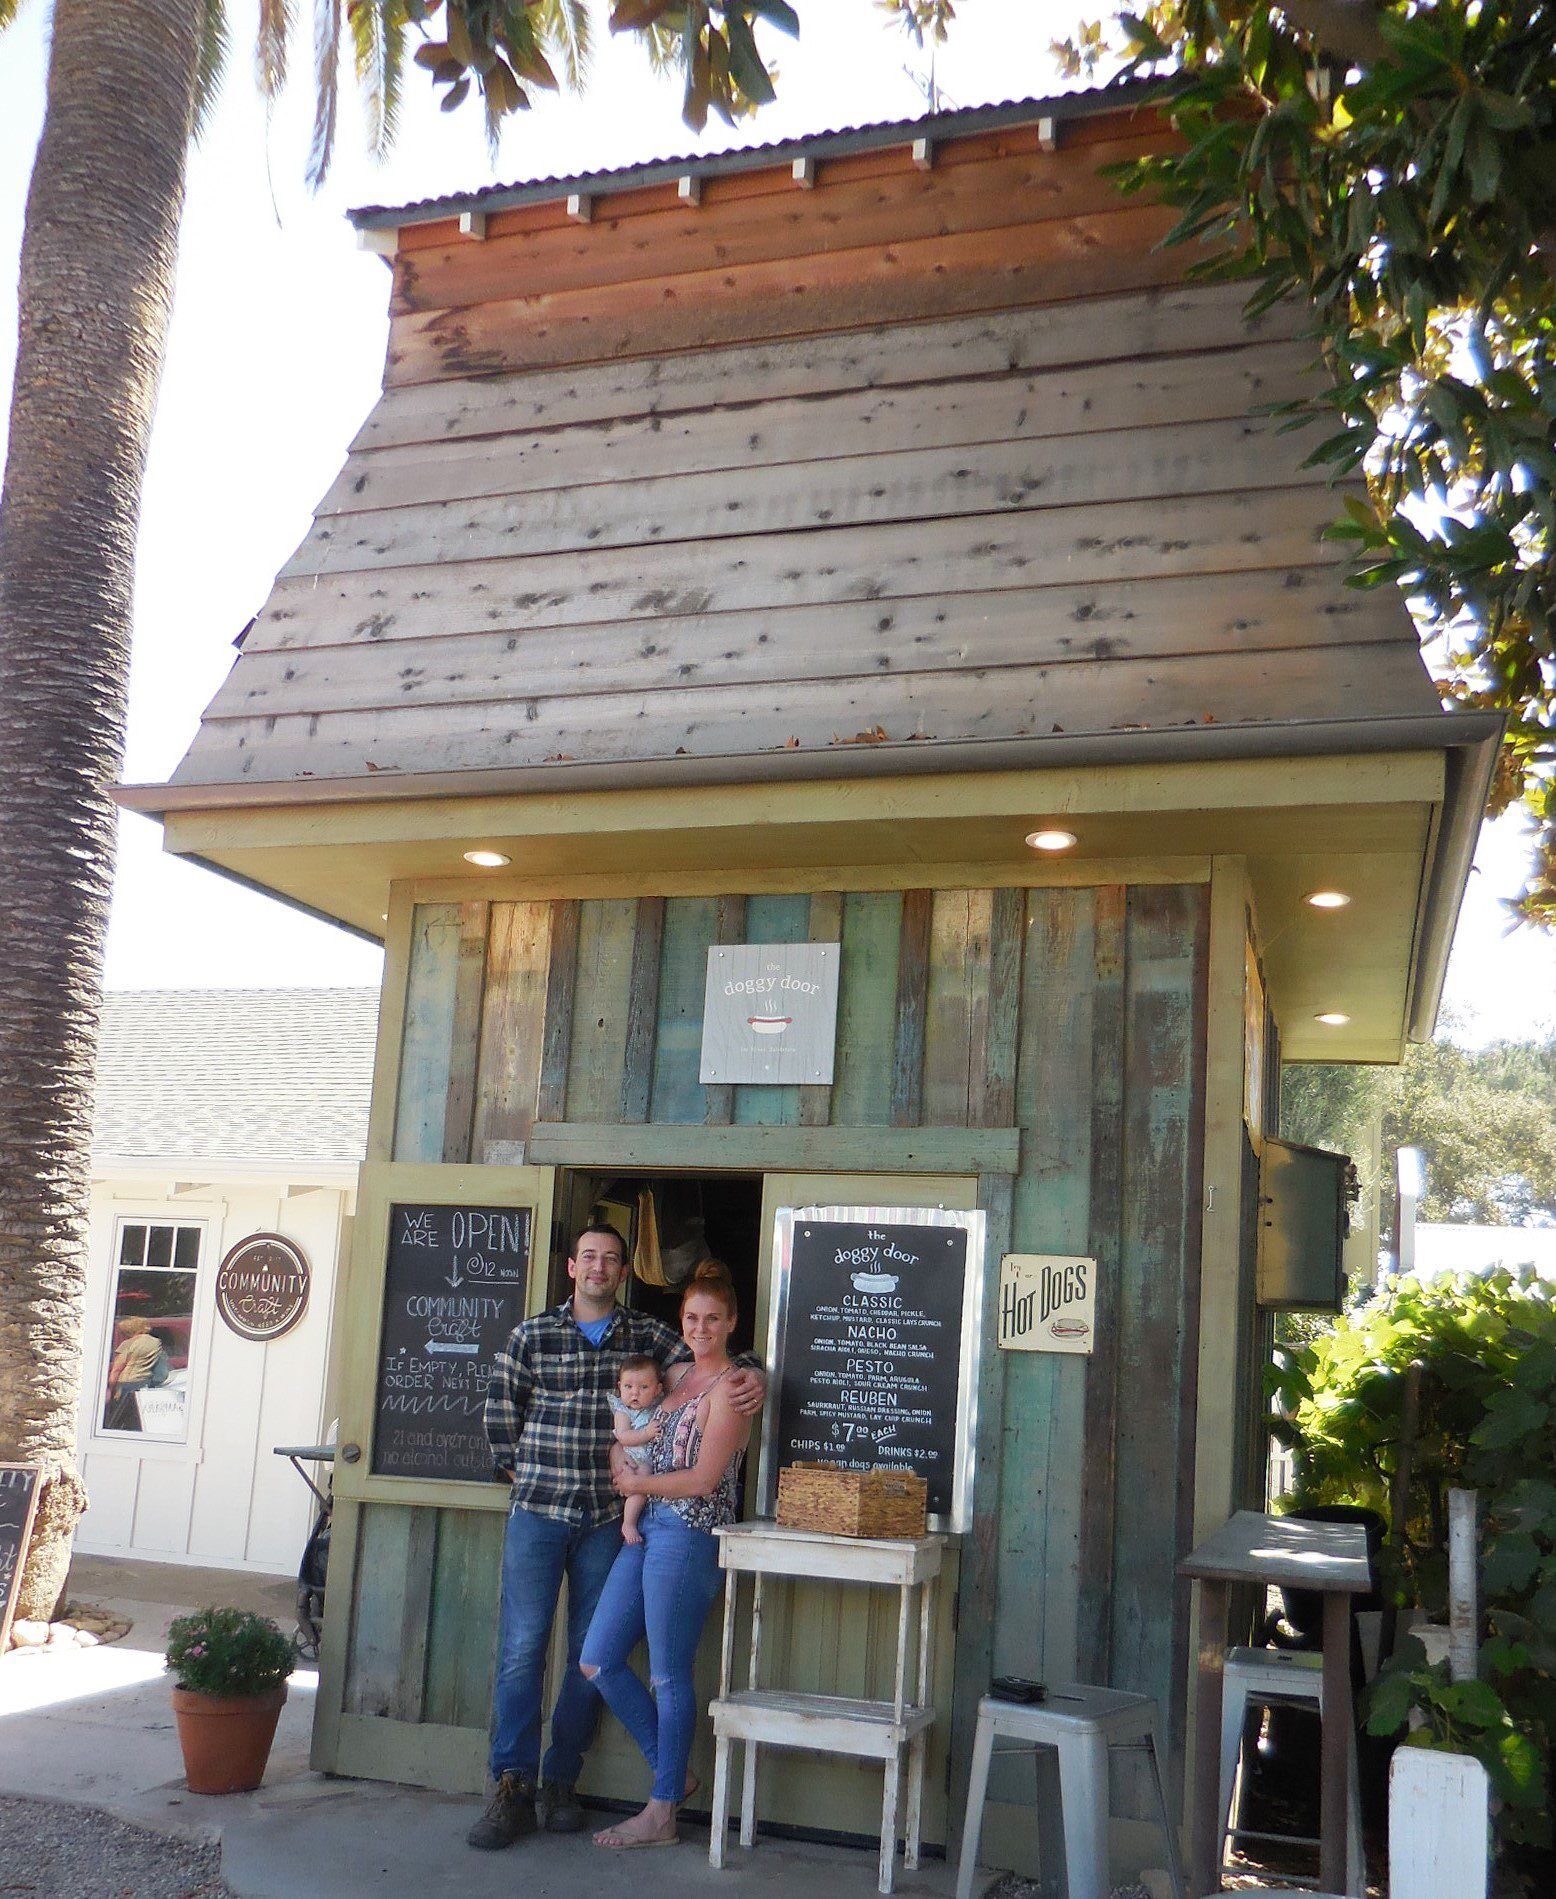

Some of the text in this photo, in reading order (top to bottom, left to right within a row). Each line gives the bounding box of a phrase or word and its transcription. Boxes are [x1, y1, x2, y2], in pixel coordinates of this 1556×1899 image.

[766, 962, 781, 971] the
[724, 974, 821, 996] doggy door
[404, 1211, 435, 1229] WE
[401, 1229, 439, 1248] ARE
[452, 1211, 530, 1256] OPEN!
[868, 1230, 887, 1241] the
[834, 1242, 920, 1265] doggy door
[219, 1271, 308, 1294] COMMUNITY
[842, 1295, 903, 1309] CLASSIC
[1040, 1265, 1087, 1323] DOGS
[238, 1295, 282, 1315] Craft
[406, 1296, 504, 1319] COMMUNITY
[875, 1317, 901, 1325] CLASSIC
[426, 1317, 482, 1342] Craft
[848, 1325, 897, 1341] NACHO
[866, 1341, 888, 1349] BLACK
[889, 1342, 907, 1351] BEAN
[908, 1343, 927, 1351] SALSA
[883, 1349, 906, 1357] NACHO
[846, 1358, 894, 1374] PESTO
[385, 1374, 434, 1390] ORDER
[810, 1376, 831, 1385] PESTO
[872, 1381, 898, 1390] CREAM
[840, 1389, 898, 1406] REUBEN
[847, 1404, 876, 1413] RUSSIAN
[911, 1409, 932, 1417] ONION
[869, 1413, 882, 1421] LAY
[901, 1415, 932, 1425] CRUNCH
[870, 1424, 897, 1440] EACH
[790, 1438, 821, 1451] CHIPS
[878, 1445, 912, 1457] DRINKS
[848, 1458, 871, 1470] dogs
